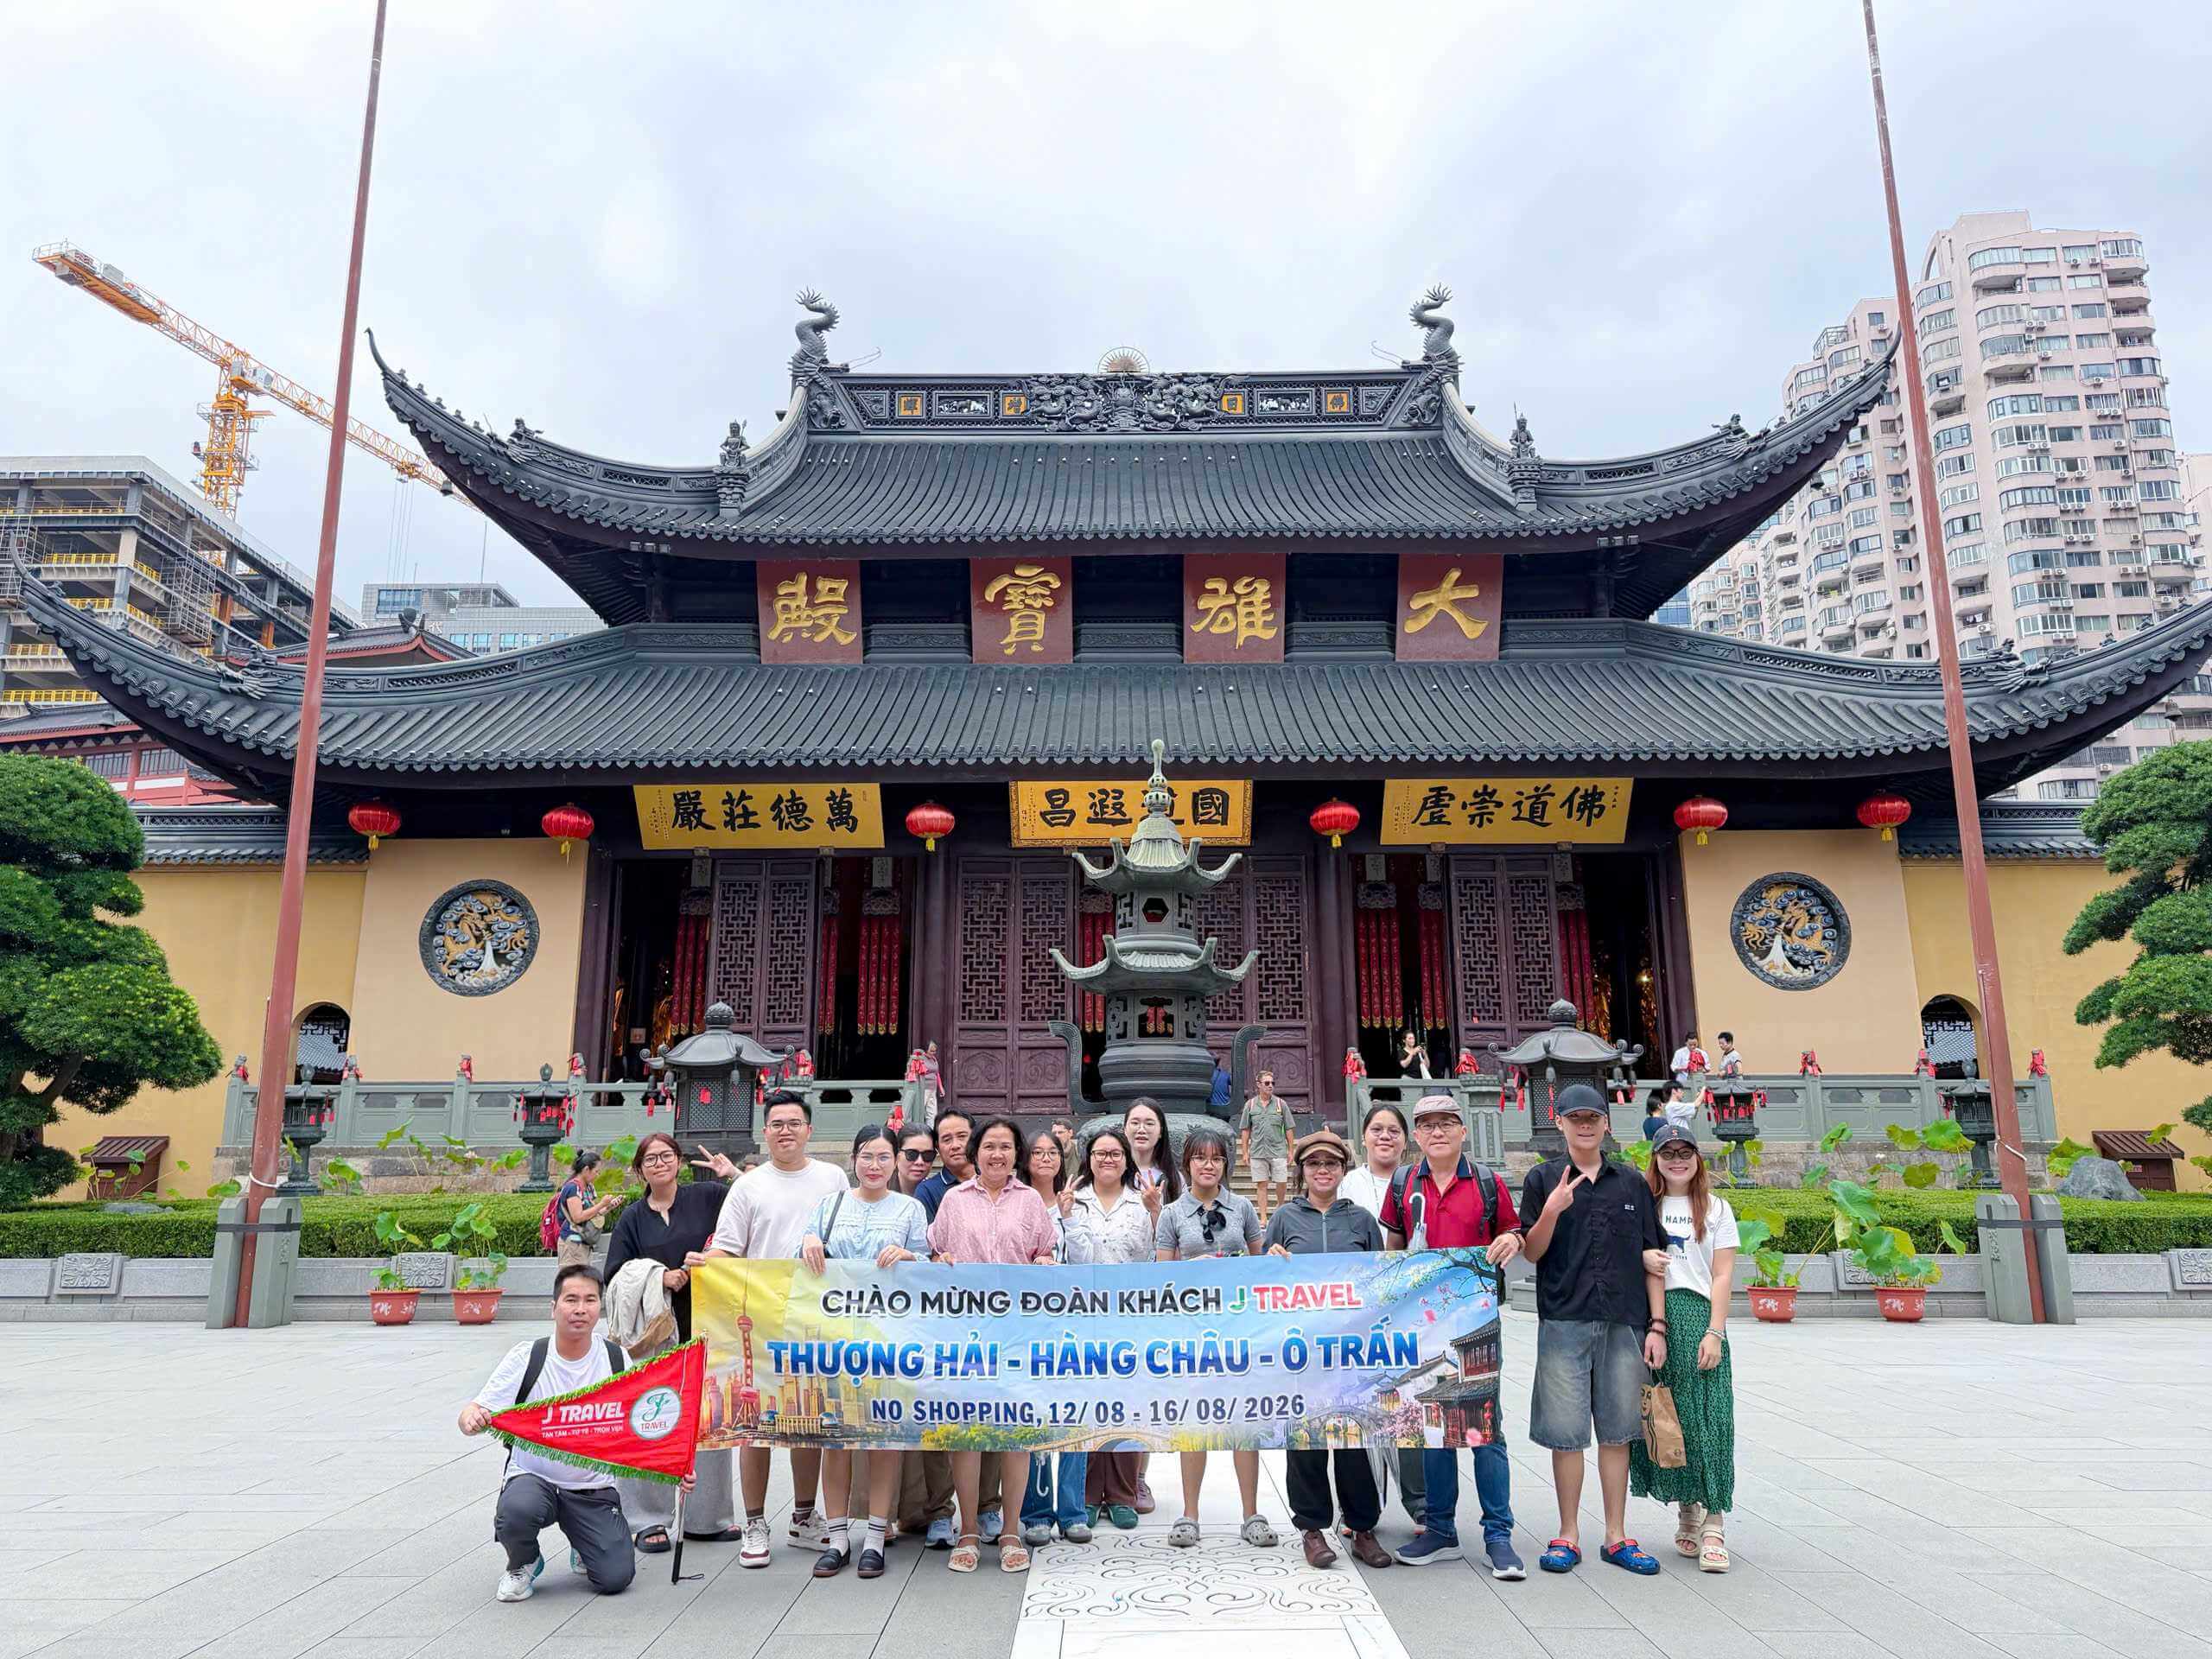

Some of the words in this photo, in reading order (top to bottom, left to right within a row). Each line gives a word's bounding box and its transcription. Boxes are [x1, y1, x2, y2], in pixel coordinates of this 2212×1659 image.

[766, 572, 858, 645] 殿
[983, 563, 1063, 657] 寶
[1190, 575, 1279, 650] 雄
[1404, 567, 1489, 639] 大
[1039, 787, 1230, 828] 國遐昌
[822, 1284, 912, 1315] CHÀO
[920, 1286, 1011, 1315] MỪNG
[1020, 1286, 1109, 1314] ĐOÀN
[1118, 1282, 1221, 1314] KHÁCH
[1229, 1287, 1246, 1312] J
[1253, 1283, 1362, 1311] TRAVEL
[767, 1340, 927, 1386] THƯỢNG
[934, 1331, 999, 1376] HẢI
[1030, 1331, 1138, 1377] HÀNG
[1146, 1330, 1252, 1375] CHÂU
[1282, 1328, 1308, 1370] Ô
[1315, 1315, 1420, 1369] TRẤN
[541, 1405, 554, 1425] J
[559, 1402, 625, 1424] TRAVEL
[640, 1421, 670, 1432] TRAVEL
[872, 1400, 903, 1421] NO
[1244, 1395, 1305, 1419] 2026
